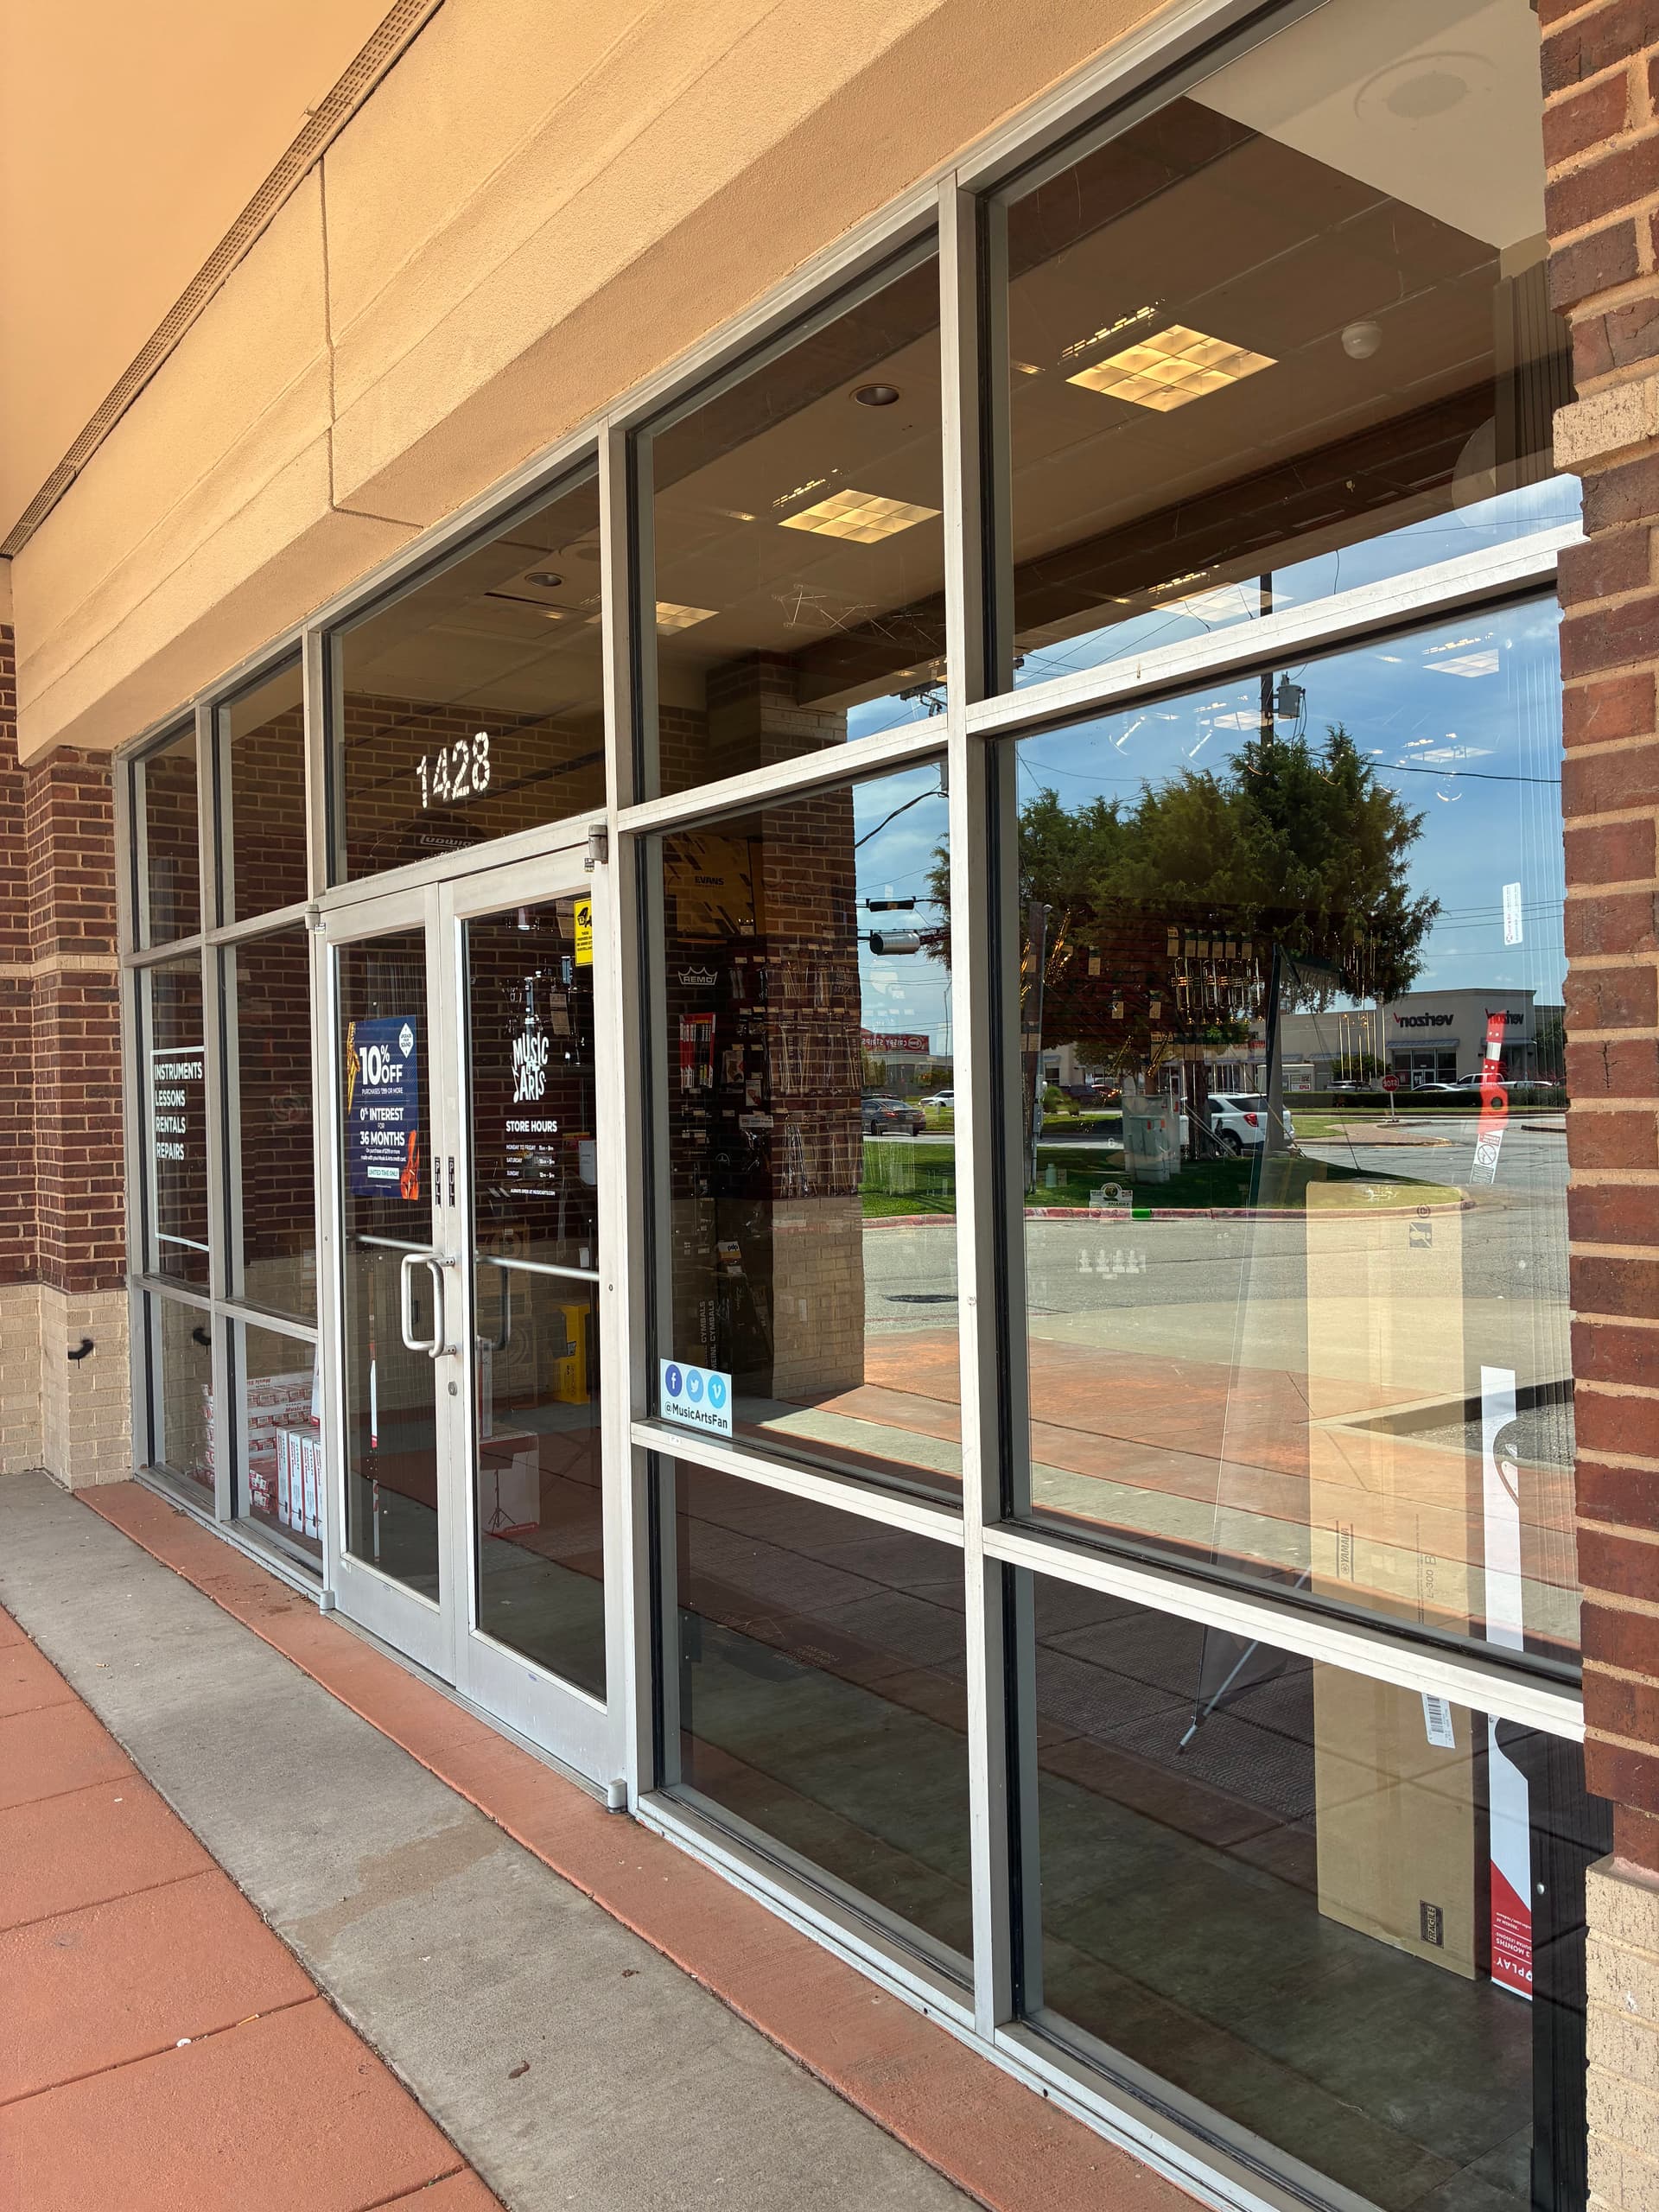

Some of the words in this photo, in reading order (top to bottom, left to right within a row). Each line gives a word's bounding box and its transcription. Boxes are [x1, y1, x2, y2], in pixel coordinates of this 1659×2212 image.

[416, 732, 490, 809] 1428
[695, 876, 724, 885] EVANS
[512, 1032, 550, 1071] MUSIC
[155, 1062, 202, 1080] INSTRUMENTS
[381, 1065, 403, 1084] OFF
[519, 1065, 545, 1101] ARTS
[156, 1090, 185, 1106] LESSONS
[370, 1108, 404, 1121] INTEREST
[156, 1116, 186, 1134] RENTALS
[506, 1121, 530, 1132] STORE
[531, 1121, 557, 1132] HOURS
[359, 1131, 369, 1145] 36
[371, 1131, 405, 1146] MONTHS
[156, 1142, 184, 1160] REPAIRS
[664, 1401, 728, 1429] @MusicArtsFan
[1341, 1529, 1350, 1563] YAMAHA
[1427, 1906, 1437, 1943] FRAGILE
[1496, 1937, 1524, 1955] MONTHS
[1496, 1956, 1524, 1978] PLAY
